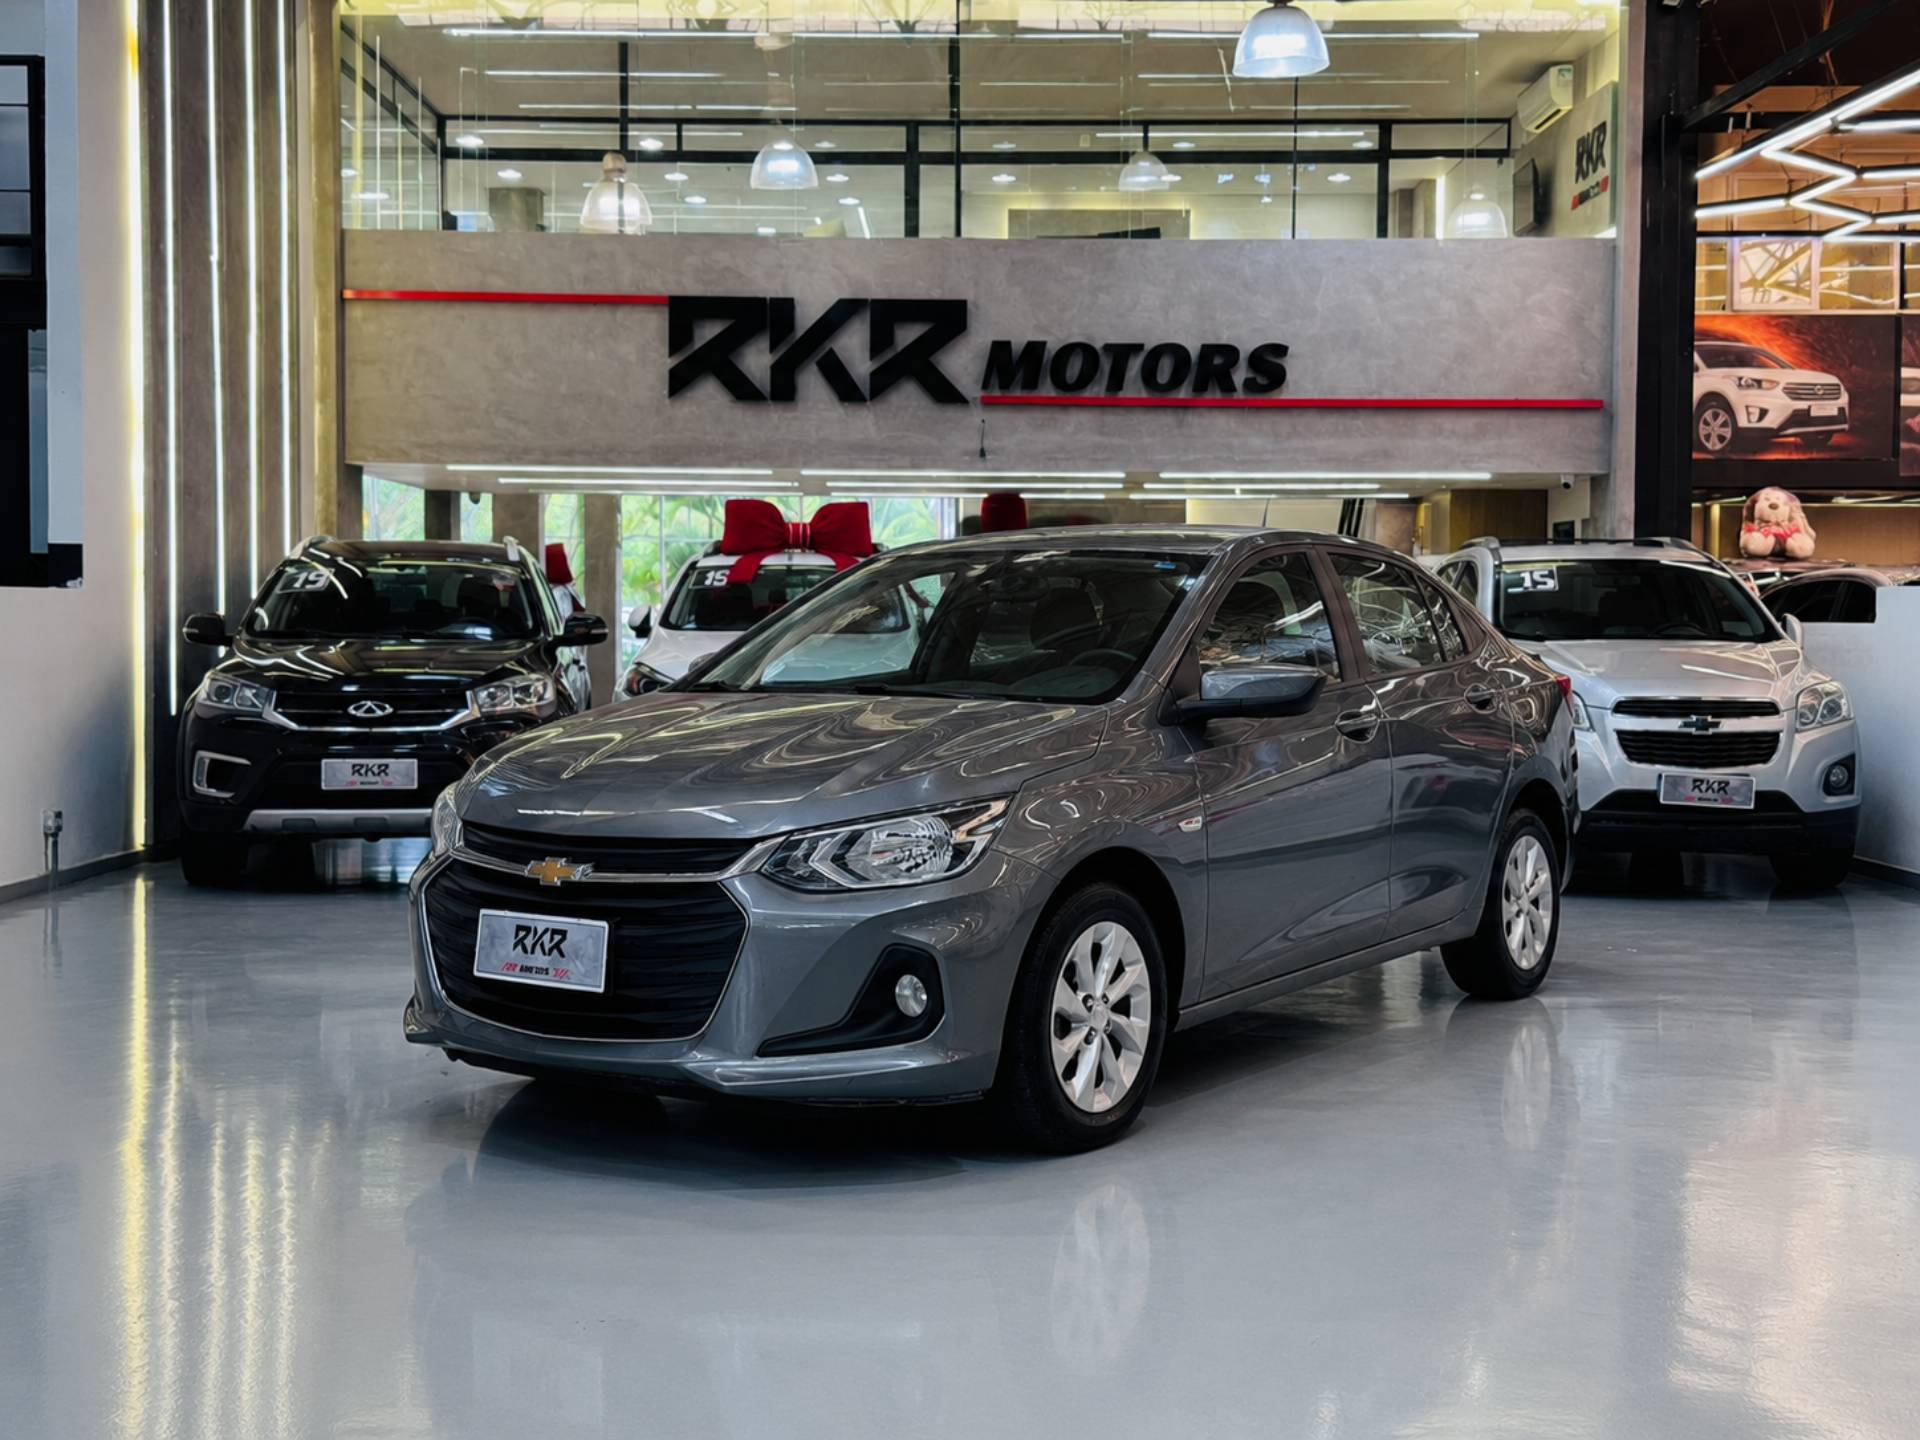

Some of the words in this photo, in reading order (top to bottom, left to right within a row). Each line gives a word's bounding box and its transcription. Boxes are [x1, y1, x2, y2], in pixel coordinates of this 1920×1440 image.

[668, 295, 970, 405] RKR
[981, 340, 1289, 393] MOTORS
[292, 570, 328, 590] 19
[704, 569, 730, 586] 15
[1520, 569, 1555, 590] 15
[351, 763, 390, 777] RKR
[1691, 778, 1730, 795] RKR
[512, 924, 568, 958] RKR
